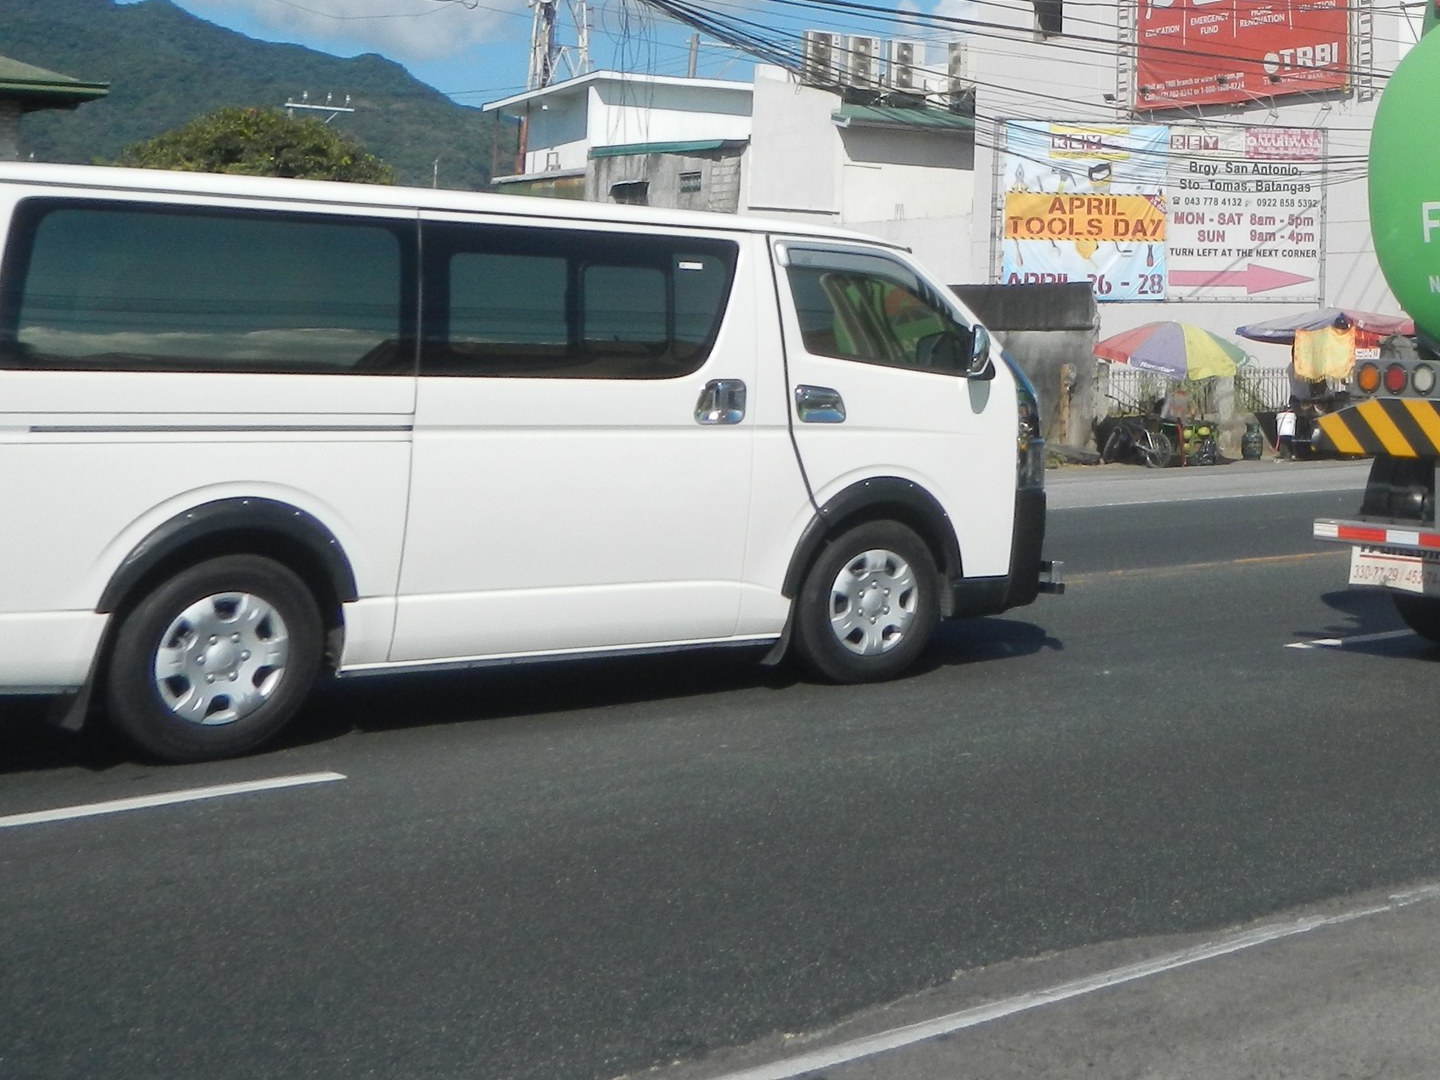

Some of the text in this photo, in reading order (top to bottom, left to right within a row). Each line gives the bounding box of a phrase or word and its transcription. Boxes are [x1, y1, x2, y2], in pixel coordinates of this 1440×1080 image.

[1190, 12, 1229, 25] EMERGENCY
[1240, 14, 1285, 27] RENOVATION
[1146, 25, 1180, 37] EDUCATION
[1200, 25, 1218, 35] FUND
[1279, 42, 1338, 70] TRBI
[1171, 135, 1218, 150] REY
[1259, 135, 1320, 148] MARIWASA
[1189, 161, 1219, 176] Brgy.
[1225, 161, 1248, 173] San
[1179, 179, 1311, 193] Sto. Tomas, Batangas
[1049, 196, 1126, 216] APRIL
[1184, 197, 1318, 208] 043 778 4132 0922 858 5392
[1008, 216, 1163, 238] TOOLS DAY
[1174, 212, 1206, 225] MON
[1217, 213, 1244, 226] SAT
[1250, 213, 1276, 226] 8am
[1288, 213, 1314, 228] 5pm
[1197, 230, 1226, 242] SUN
[1250, 230, 1276, 242] 9am
[1288, 230, 1315, 245] 4pm
[1170, 248, 1317, 258] TURN LEFT AT THE NEXT CORNER
[1138, 274, 1163, 294] 28
[1353, 564, 1398, 582] 330-77-29
